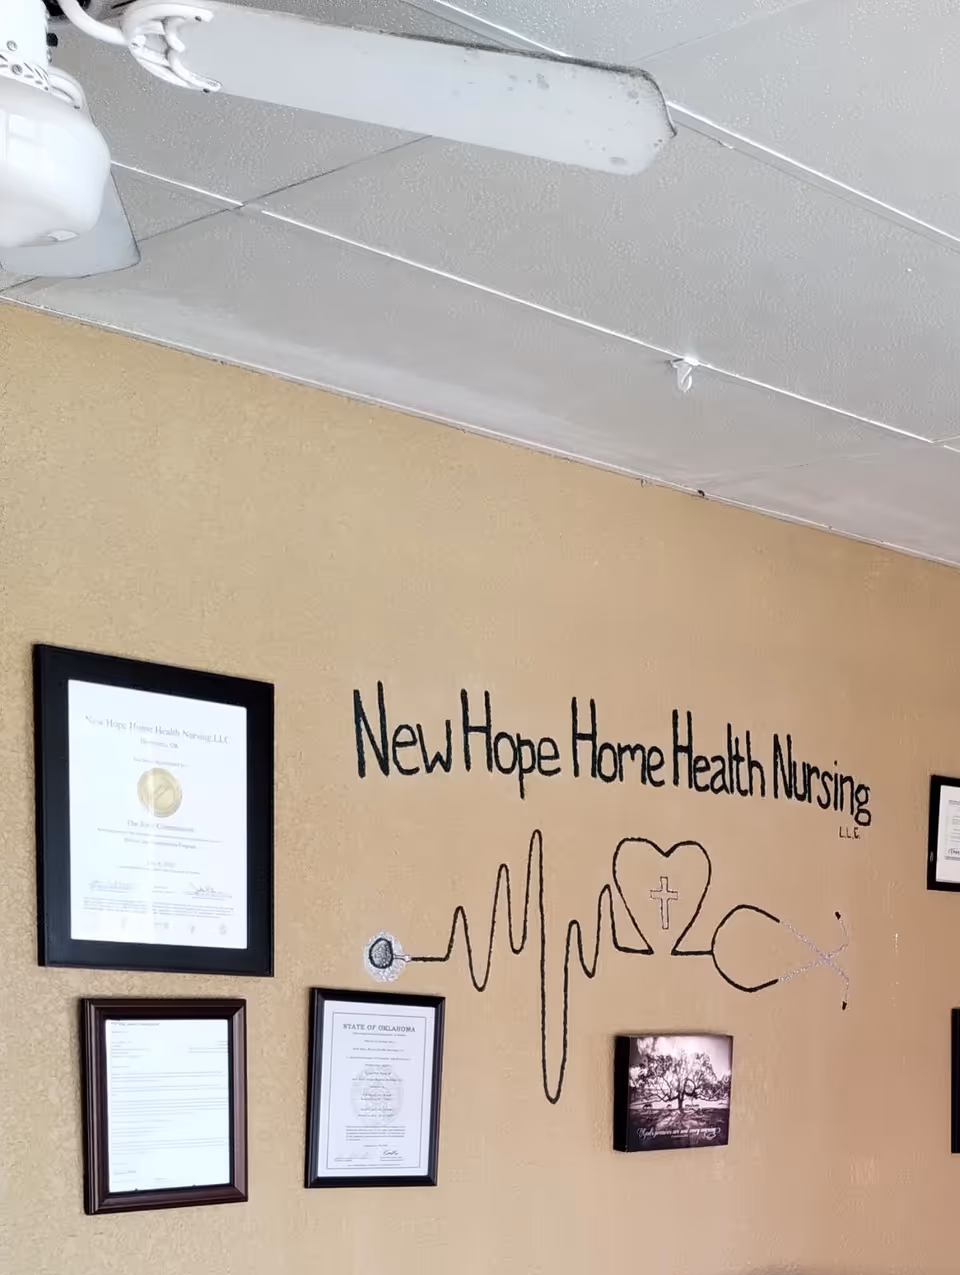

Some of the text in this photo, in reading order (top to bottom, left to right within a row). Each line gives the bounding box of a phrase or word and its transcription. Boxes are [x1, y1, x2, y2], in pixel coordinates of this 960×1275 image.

[353, 680, 872, 826] New Hope Home Health Nursing
[343, 1023, 366, 1031] STATE
